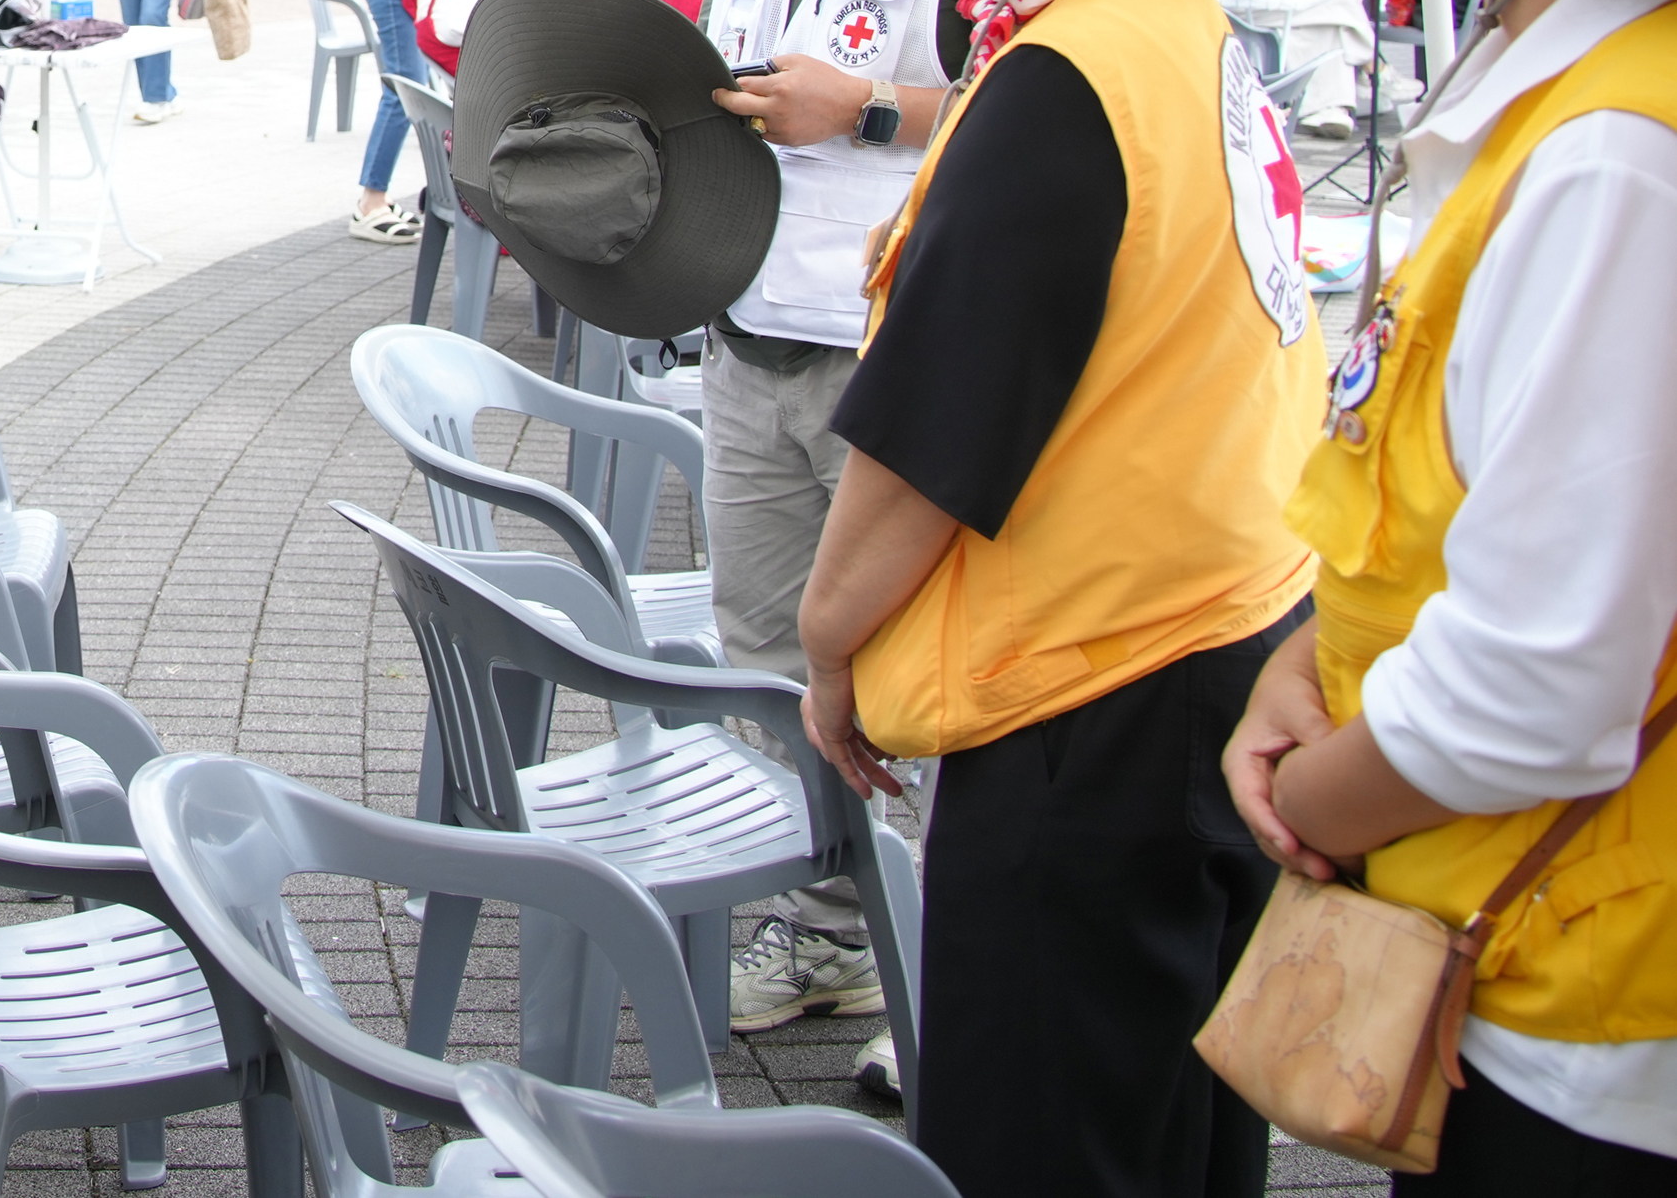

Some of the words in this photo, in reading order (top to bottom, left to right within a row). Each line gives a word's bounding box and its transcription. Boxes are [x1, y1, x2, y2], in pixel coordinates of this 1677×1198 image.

[833, 0, 862, 26] KOREAN
[862, 0, 878, 13] RED
[874, 8, 888, 35] CROSS
[829, 37, 880, 65] 대한적십자사
